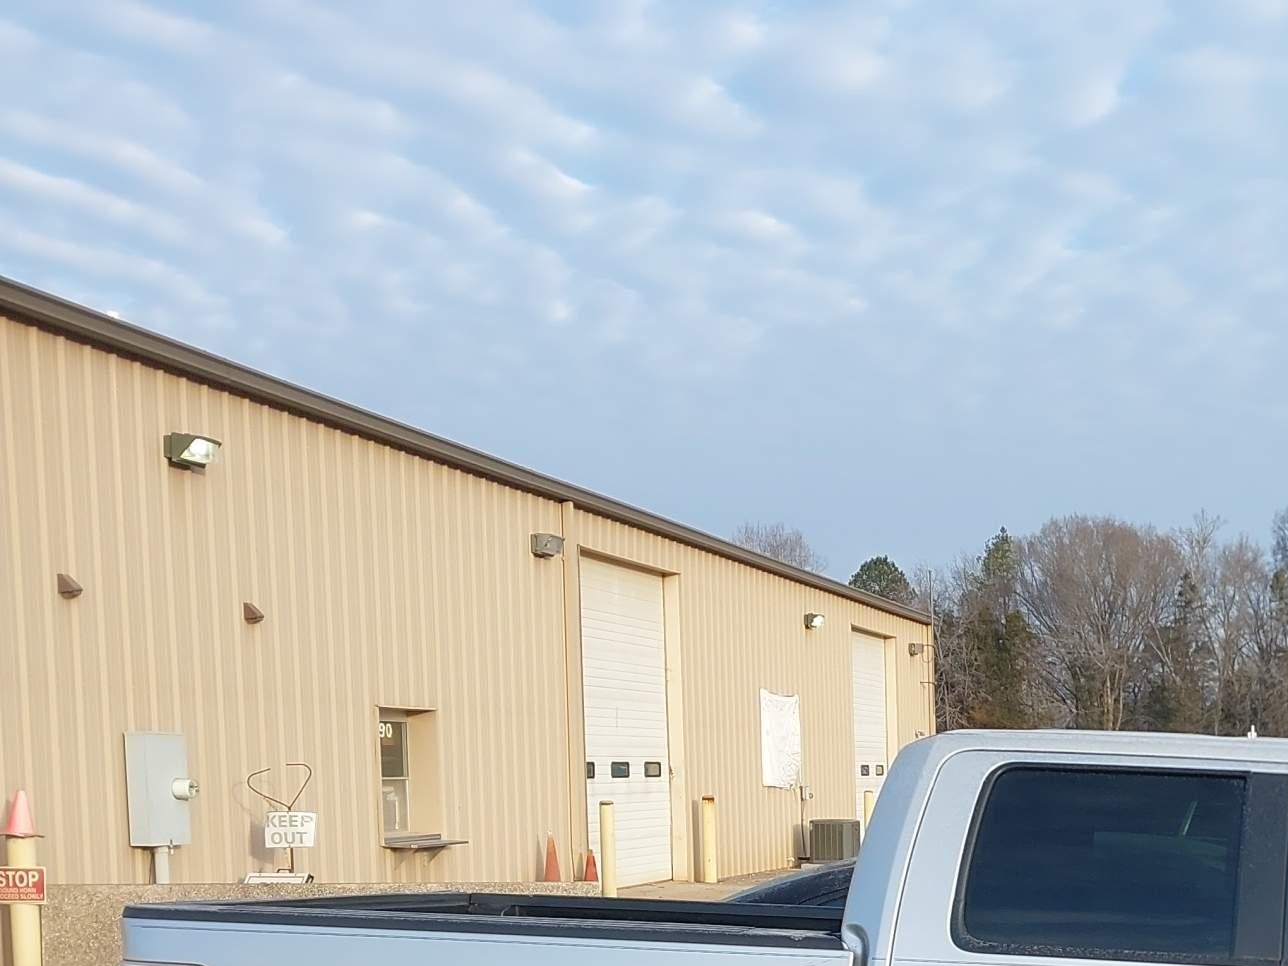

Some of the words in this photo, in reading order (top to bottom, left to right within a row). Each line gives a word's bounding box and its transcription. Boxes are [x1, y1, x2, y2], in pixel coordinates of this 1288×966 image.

[266, 814, 313, 828] KEEP
[271, 831, 308, 845] OUT
[0, 871, 39, 888] STOP
